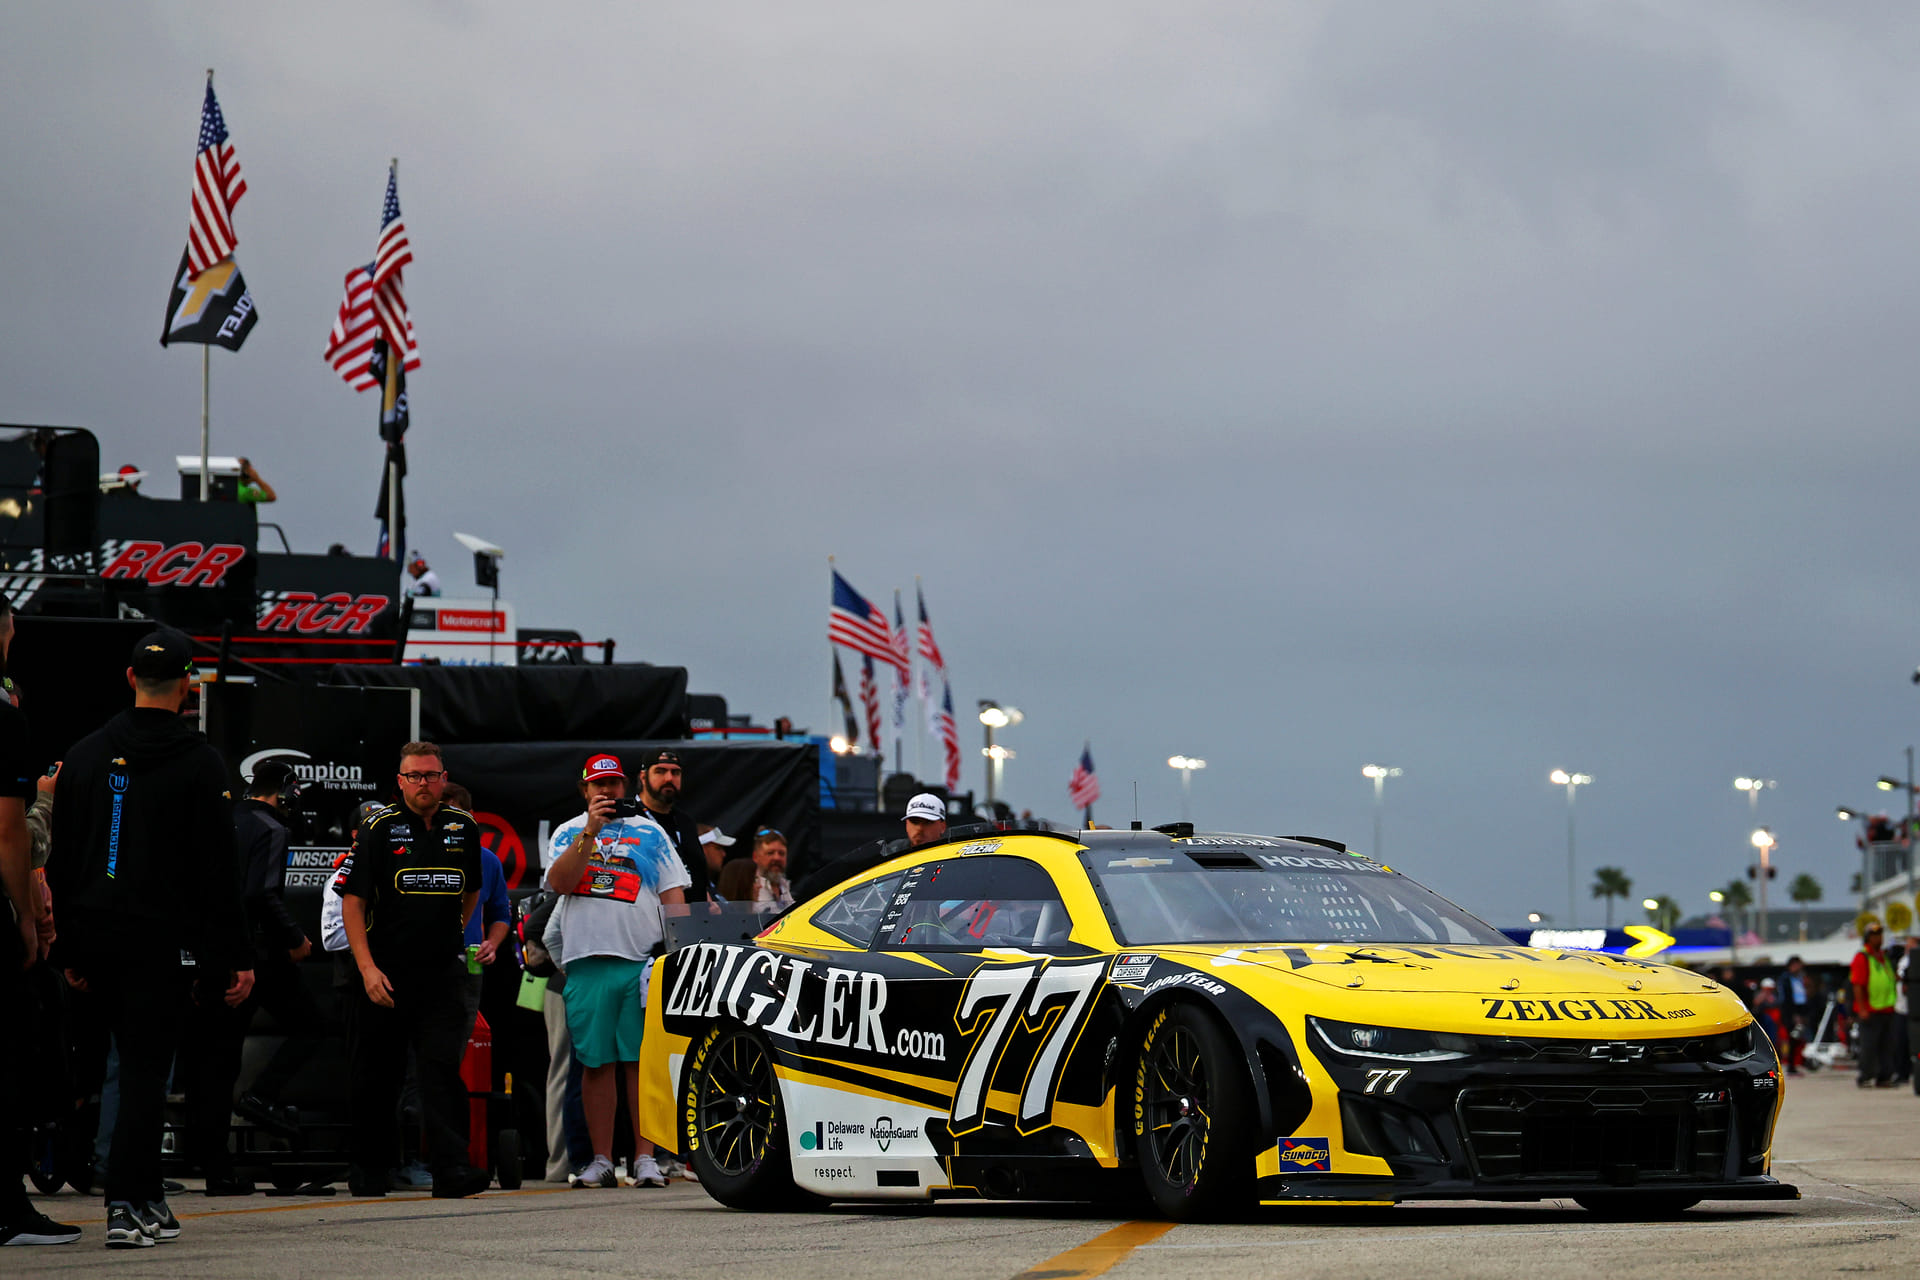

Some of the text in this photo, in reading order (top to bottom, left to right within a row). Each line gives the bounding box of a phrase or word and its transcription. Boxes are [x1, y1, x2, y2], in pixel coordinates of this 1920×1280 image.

[100, 540, 246, 588] RCR
[256, 591, 389, 634] RCR
[323, 781, 377, 791] Tire & Wheel
[951, 961, 1106, 1130] 77
[1365, 1069, 1410, 1094] 77
[828, 1121, 865, 1135] Delaware
[870, 1126, 919, 1140] NationsGuard
[828, 1137, 844, 1151] Life
[1282, 1150, 1327, 1161] SUNOCO
[814, 1165, 856, 1181] respect.
